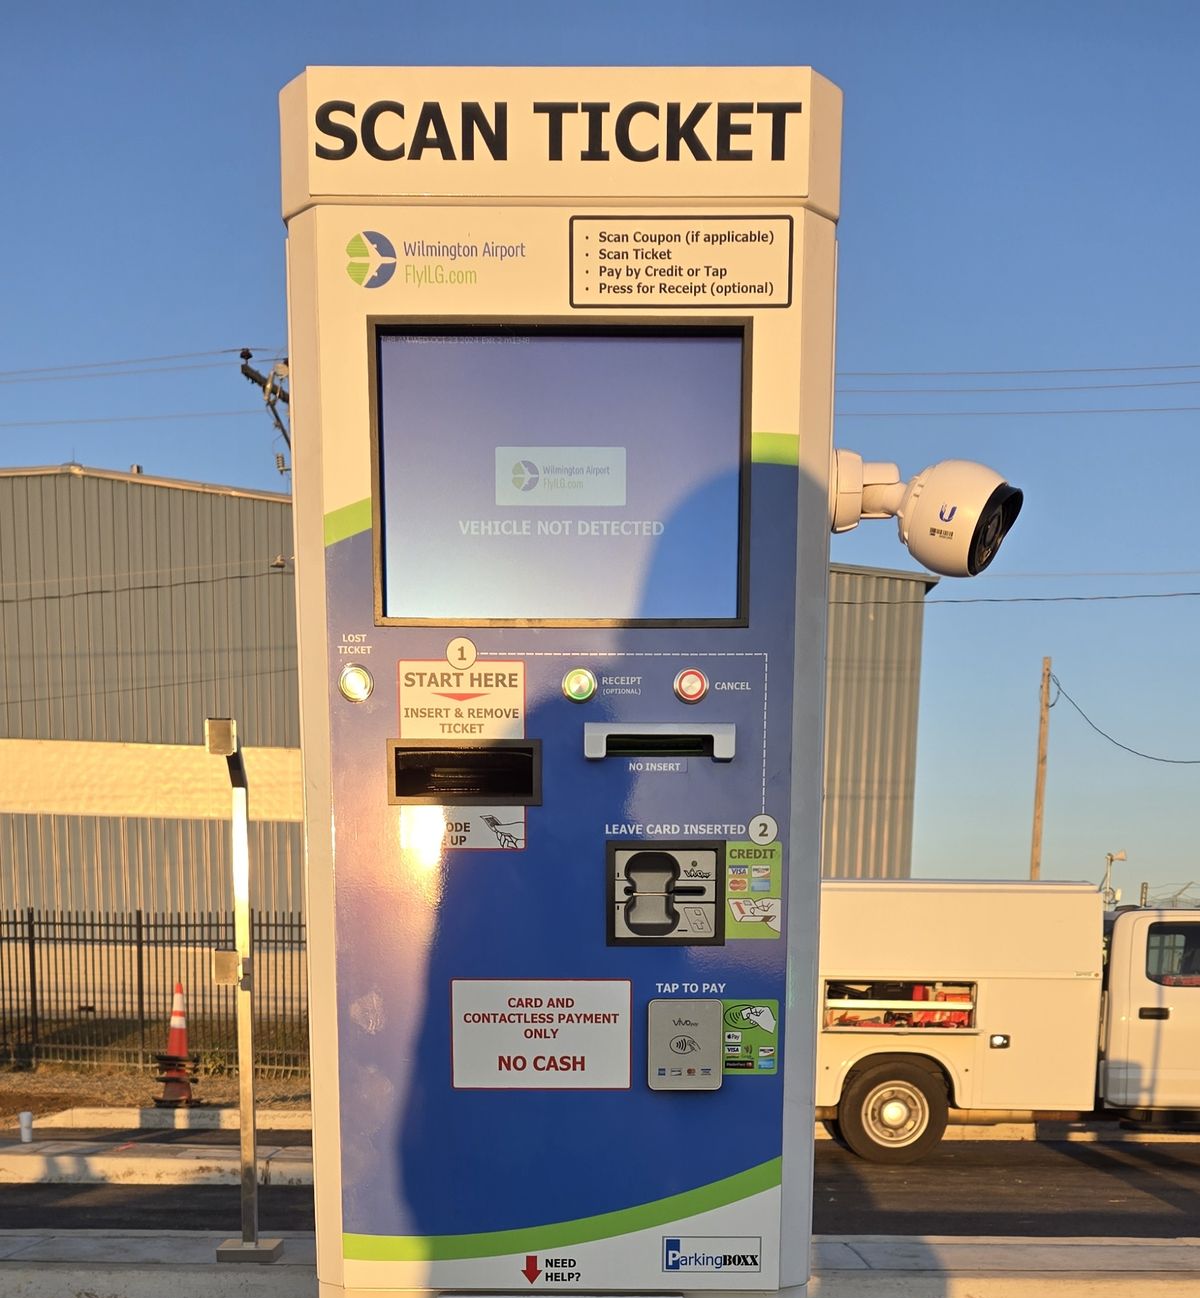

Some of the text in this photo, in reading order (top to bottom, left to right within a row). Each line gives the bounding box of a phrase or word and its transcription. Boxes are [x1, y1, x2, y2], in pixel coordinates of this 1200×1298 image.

[315, 100, 802, 162] SCAN TICKET
[598, 230, 774, 245] Scan Coupon (if applicable)
[404, 241, 526, 261] Wilmington Airport
[598, 248, 672, 260] Scan Ticket
[405, 264, 477, 288] FlyILG.com
[599, 265, 727, 279] Pay by Credit or Tap
[599, 281, 774, 296] Press for Receipt (optional)
[543, 465, 610, 476] Wilmington Airport
[543, 477, 584, 490] FlyILG.com
[458, 520, 665, 536] VEHICLE NOT DETECTED
[342, 634, 367, 643] LOST
[337, 646, 372, 654] TICKET
[458, 646, 466, 661] 1
[404, 672, 518, 688] START HERE
[602, 677, 642, 685] RECEIPT
[714, 682, 751, 690] CANCEL
[602, 688, 642, 696] (OPTIONAL)
[404, 708, 519, 718] INSERT & REMOVE
[440, 724, 484, 734] TICKET
[629, 763, 680, 771] NO INSERT
[445, 822, 470, 832] ODE
[605, 824, 746, 835] LEAVE CARD INSERTED
[758, 823, 768, 837] 2
[450, 836, 466, 846] UP
[729, 849, 776, 859] CREDIT
[656, 983, 726, 993] TAP TO PAY
[508, 998, 574, 1008] CARD AND
[463, 1013, 620, 1024] CONTACTLESS PAYMENT
[524, 1028, 559, 1038] ONLY
[498, 1056, 586, 1071] NO CASH
[545, 1259, 576, 1268] NEED
[545, 1272, 581, 1282] HELP?
